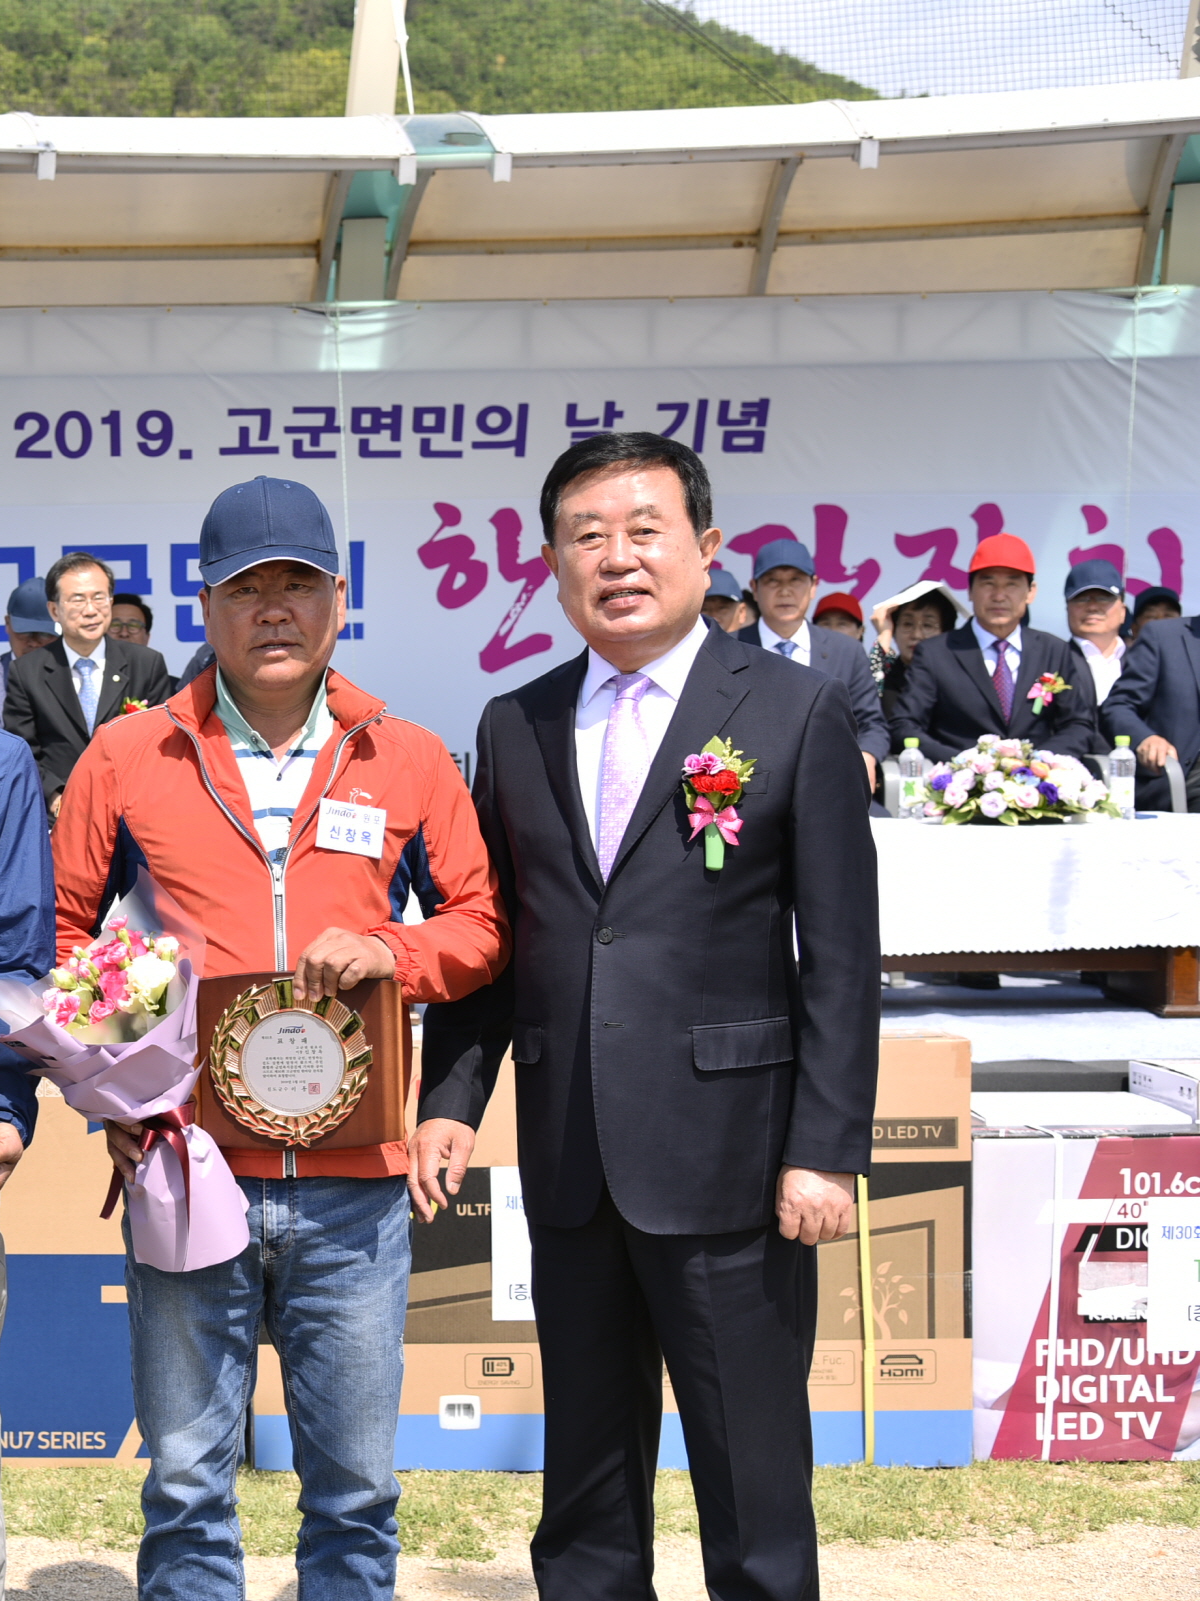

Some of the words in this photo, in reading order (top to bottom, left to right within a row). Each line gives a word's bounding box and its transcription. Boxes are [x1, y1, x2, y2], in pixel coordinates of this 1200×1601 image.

[13, 409, 193, 460] 2019.
[218, 403, 530, 459] 고군면민의
[651, 398, 771, 454] 기념
[329, 825, 372, 846] 신창옥
[887, 1126, 919, 1139] LED
[921, 1125, 943, 1139] TV
[880, 1368, 924, 1377] HDMI
[1035, 1374, 1176, 1404] DIGITAL
[1035, 1411, 1105, 1441] LED
[1114, 1411, 1163, 1440] TV
[37, 1431, 107, 1450] SERIES
